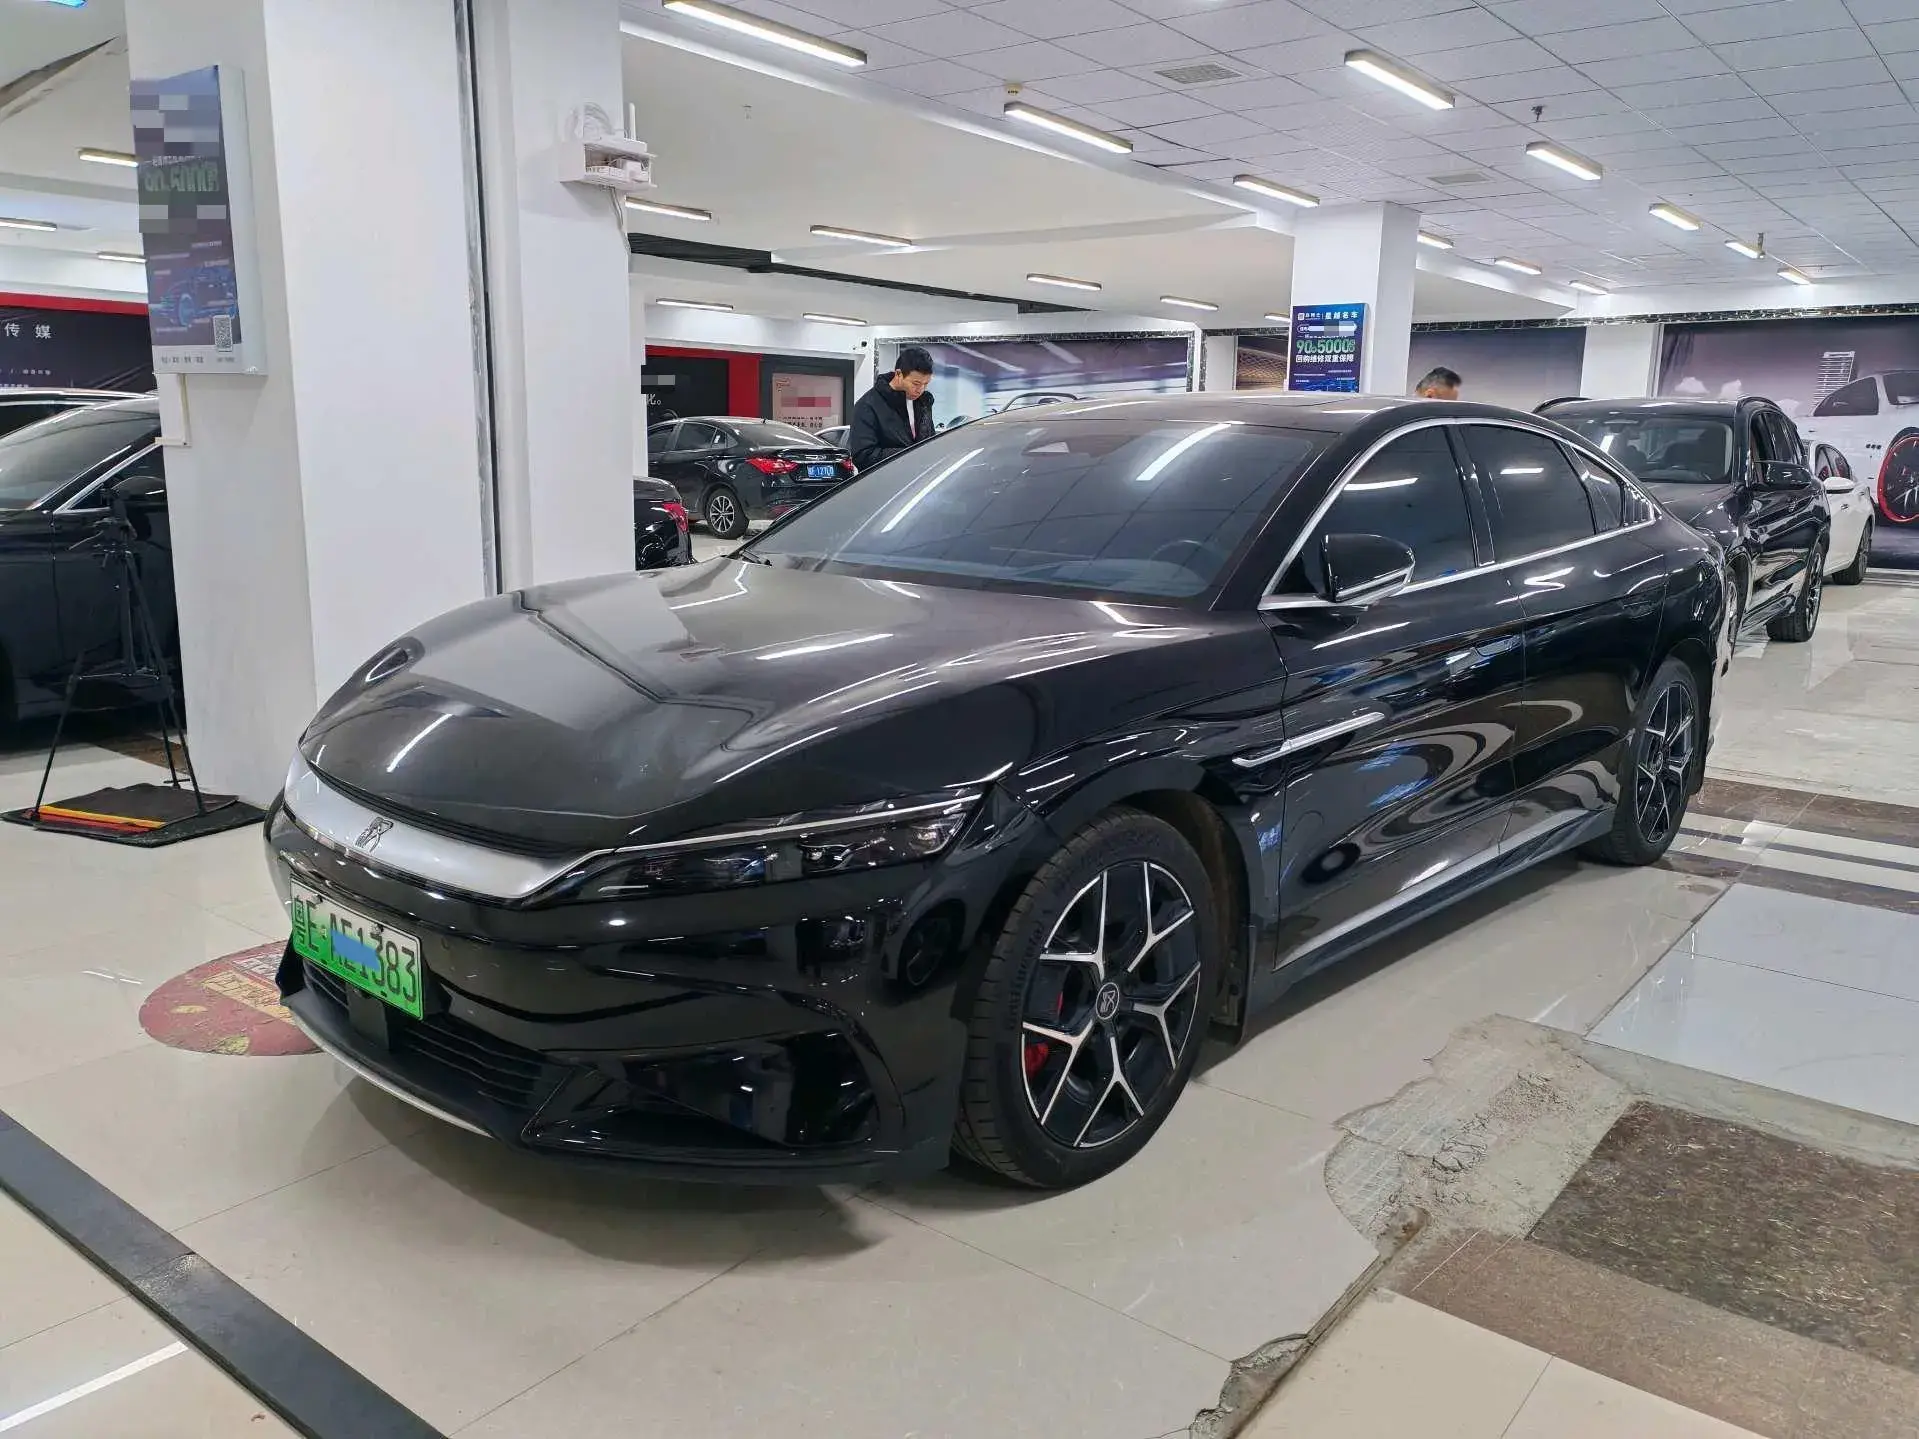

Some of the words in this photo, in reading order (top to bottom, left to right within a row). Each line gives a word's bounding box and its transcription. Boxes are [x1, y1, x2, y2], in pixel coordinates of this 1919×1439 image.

[4, 322, 52, 339] 传媒
[1295, 354, 1355, 363] 回购维修双重保障
